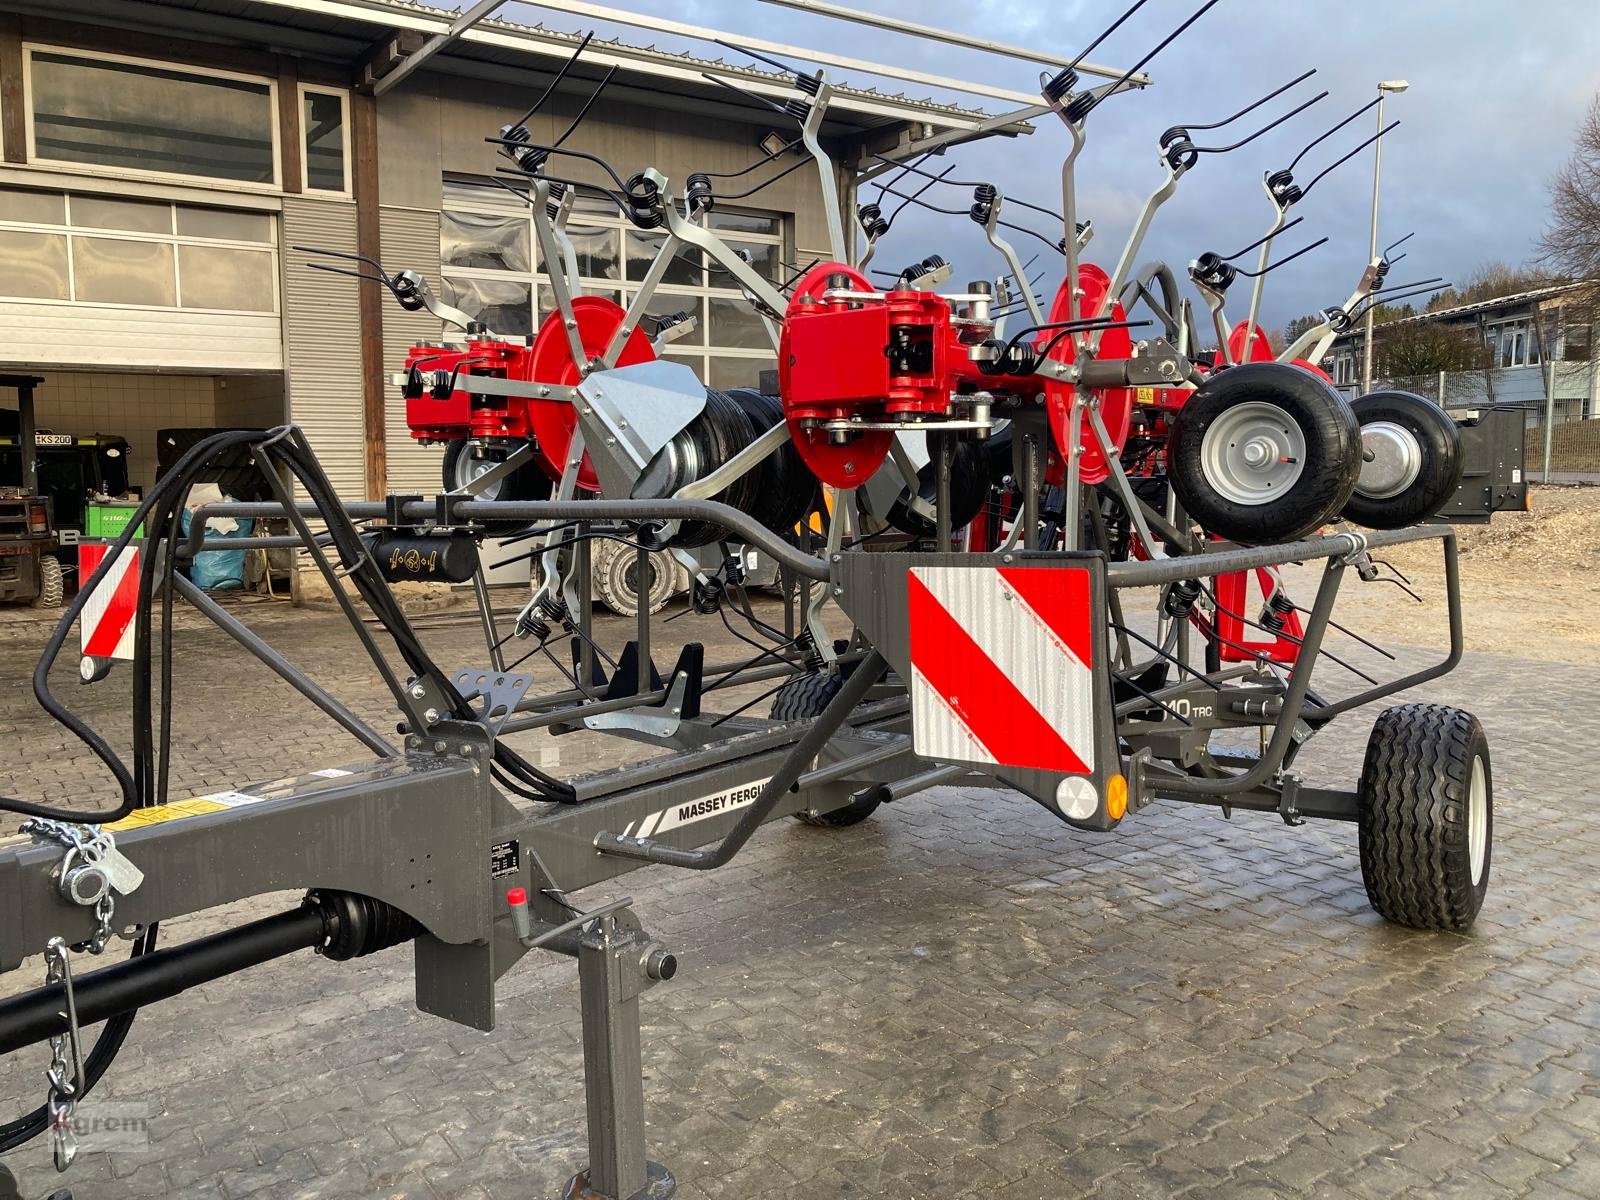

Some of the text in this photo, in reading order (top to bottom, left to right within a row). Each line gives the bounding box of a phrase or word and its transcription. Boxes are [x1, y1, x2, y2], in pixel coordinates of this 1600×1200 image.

[1192, 706, 1213, 718] TRC
[678, 783, 769, 821] MASSEY FERGU
